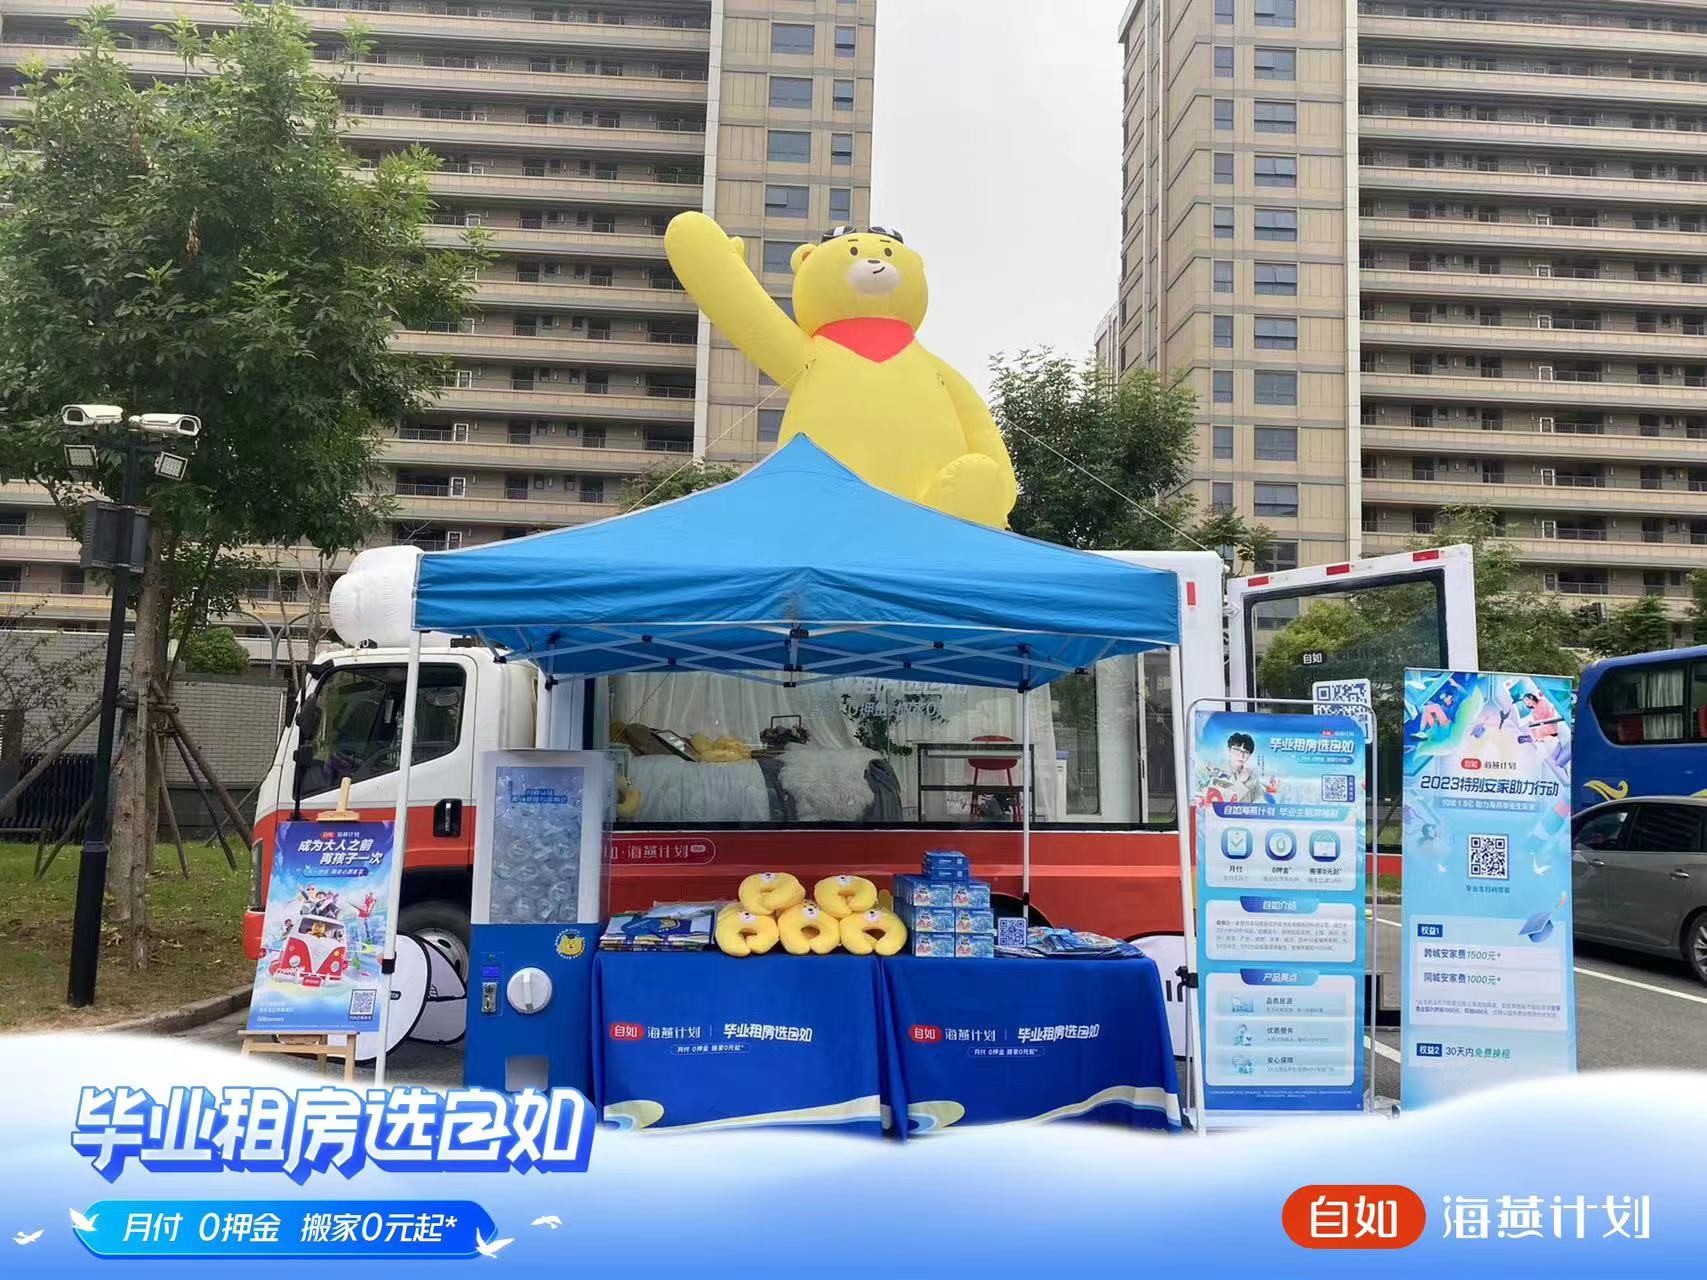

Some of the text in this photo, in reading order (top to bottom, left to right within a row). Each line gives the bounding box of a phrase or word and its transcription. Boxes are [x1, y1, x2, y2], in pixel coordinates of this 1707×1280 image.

[1303, 653, 1322, 664] 自如
[1420, 775, 1559, 797] 2023特别安家助力行动
[298, 839, 374, 852] 成为大人之前
[320, 852, 383, 865] 再孩子一次
[1421, 926, 1439, 936] 权益1
[614, 1025, 637, 1038] 自如
[648, 1025, 701, 1039] 海燕计划
[914, 1027, 936, 1039] 自如
[945, 1028, 996, 1042] 海燕计划
[1419, 1045, 1510, 1058] 权益2 30天内免费换租
